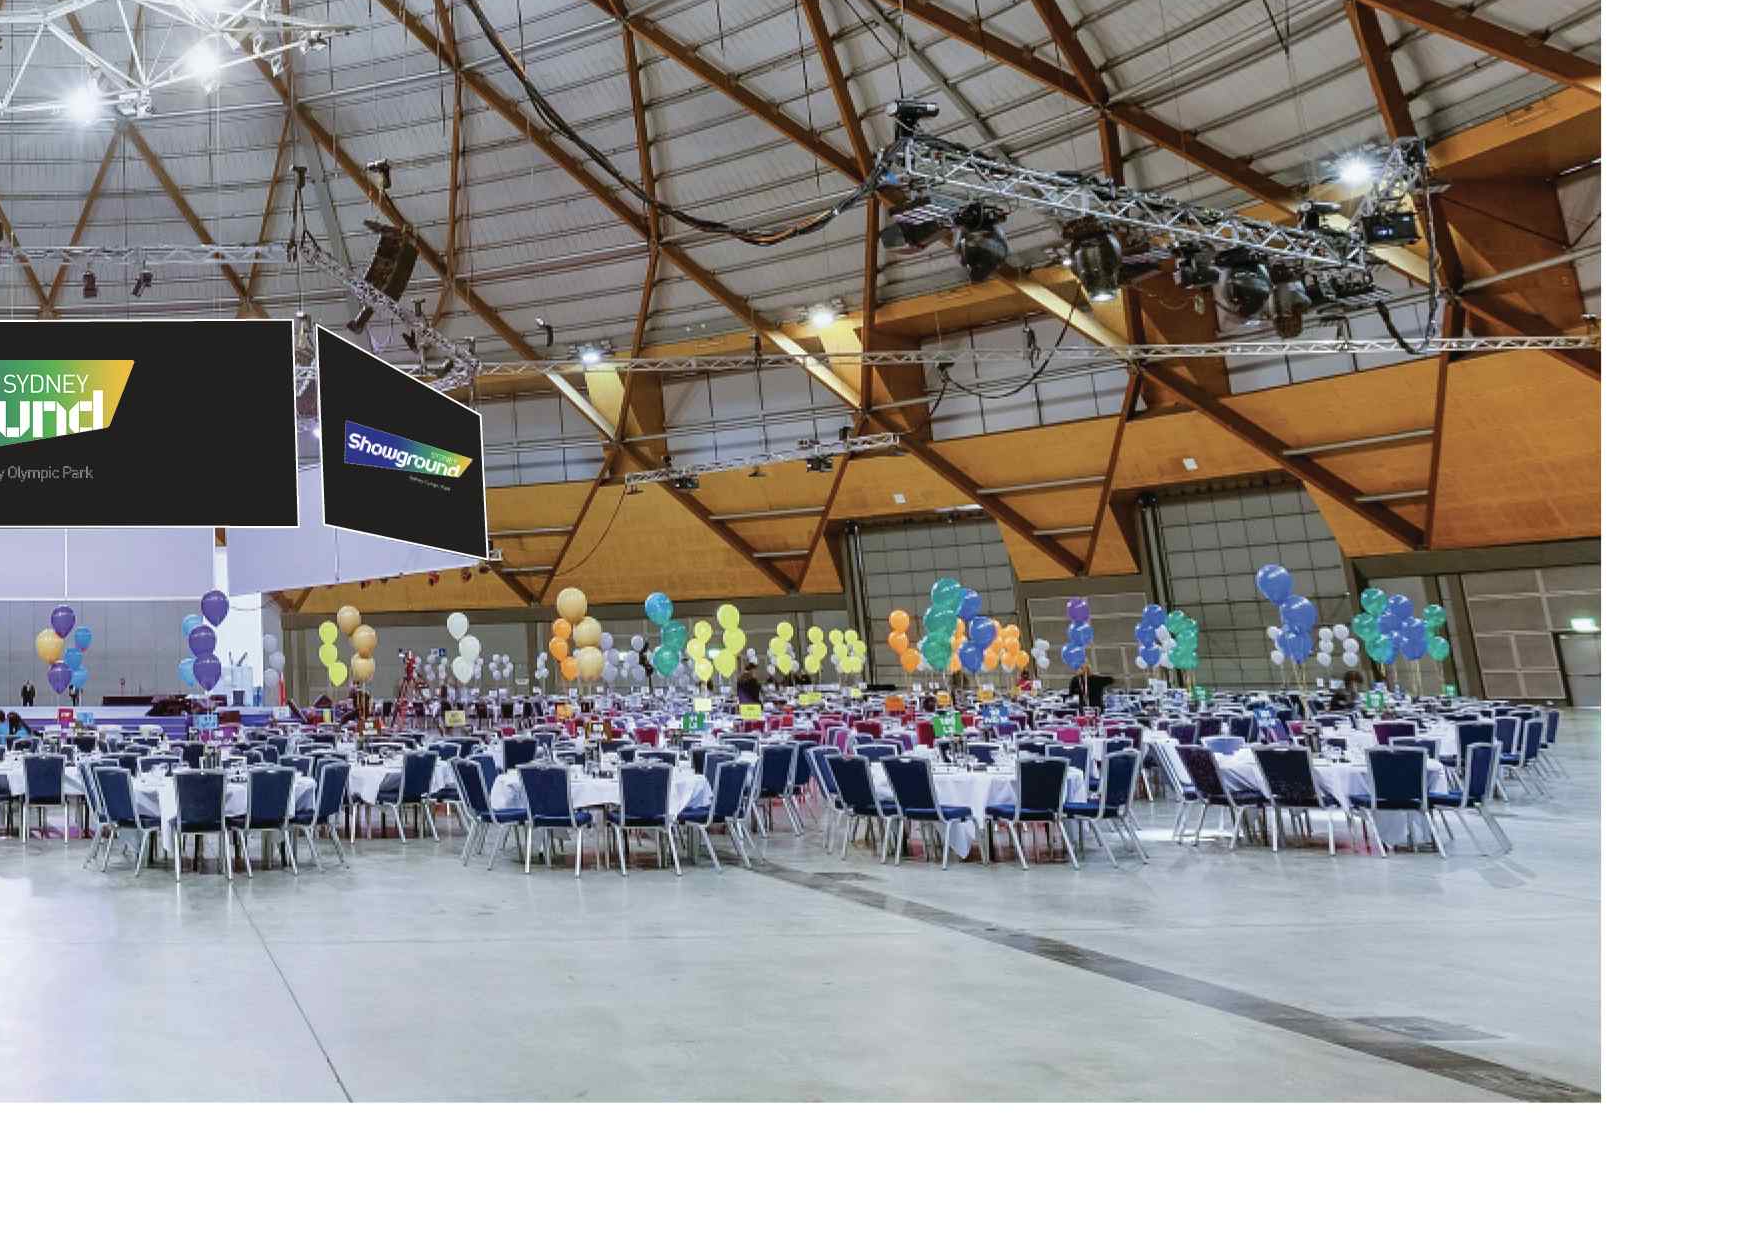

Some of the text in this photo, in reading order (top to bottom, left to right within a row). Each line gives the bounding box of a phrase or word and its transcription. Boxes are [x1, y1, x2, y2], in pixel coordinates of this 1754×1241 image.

[3, 374, 89, 394] SYDNEY
[348, 432, 461, 478] Showground
[7, 465, 60, 483] Olympic
[62, 465, 94, 479] Park
